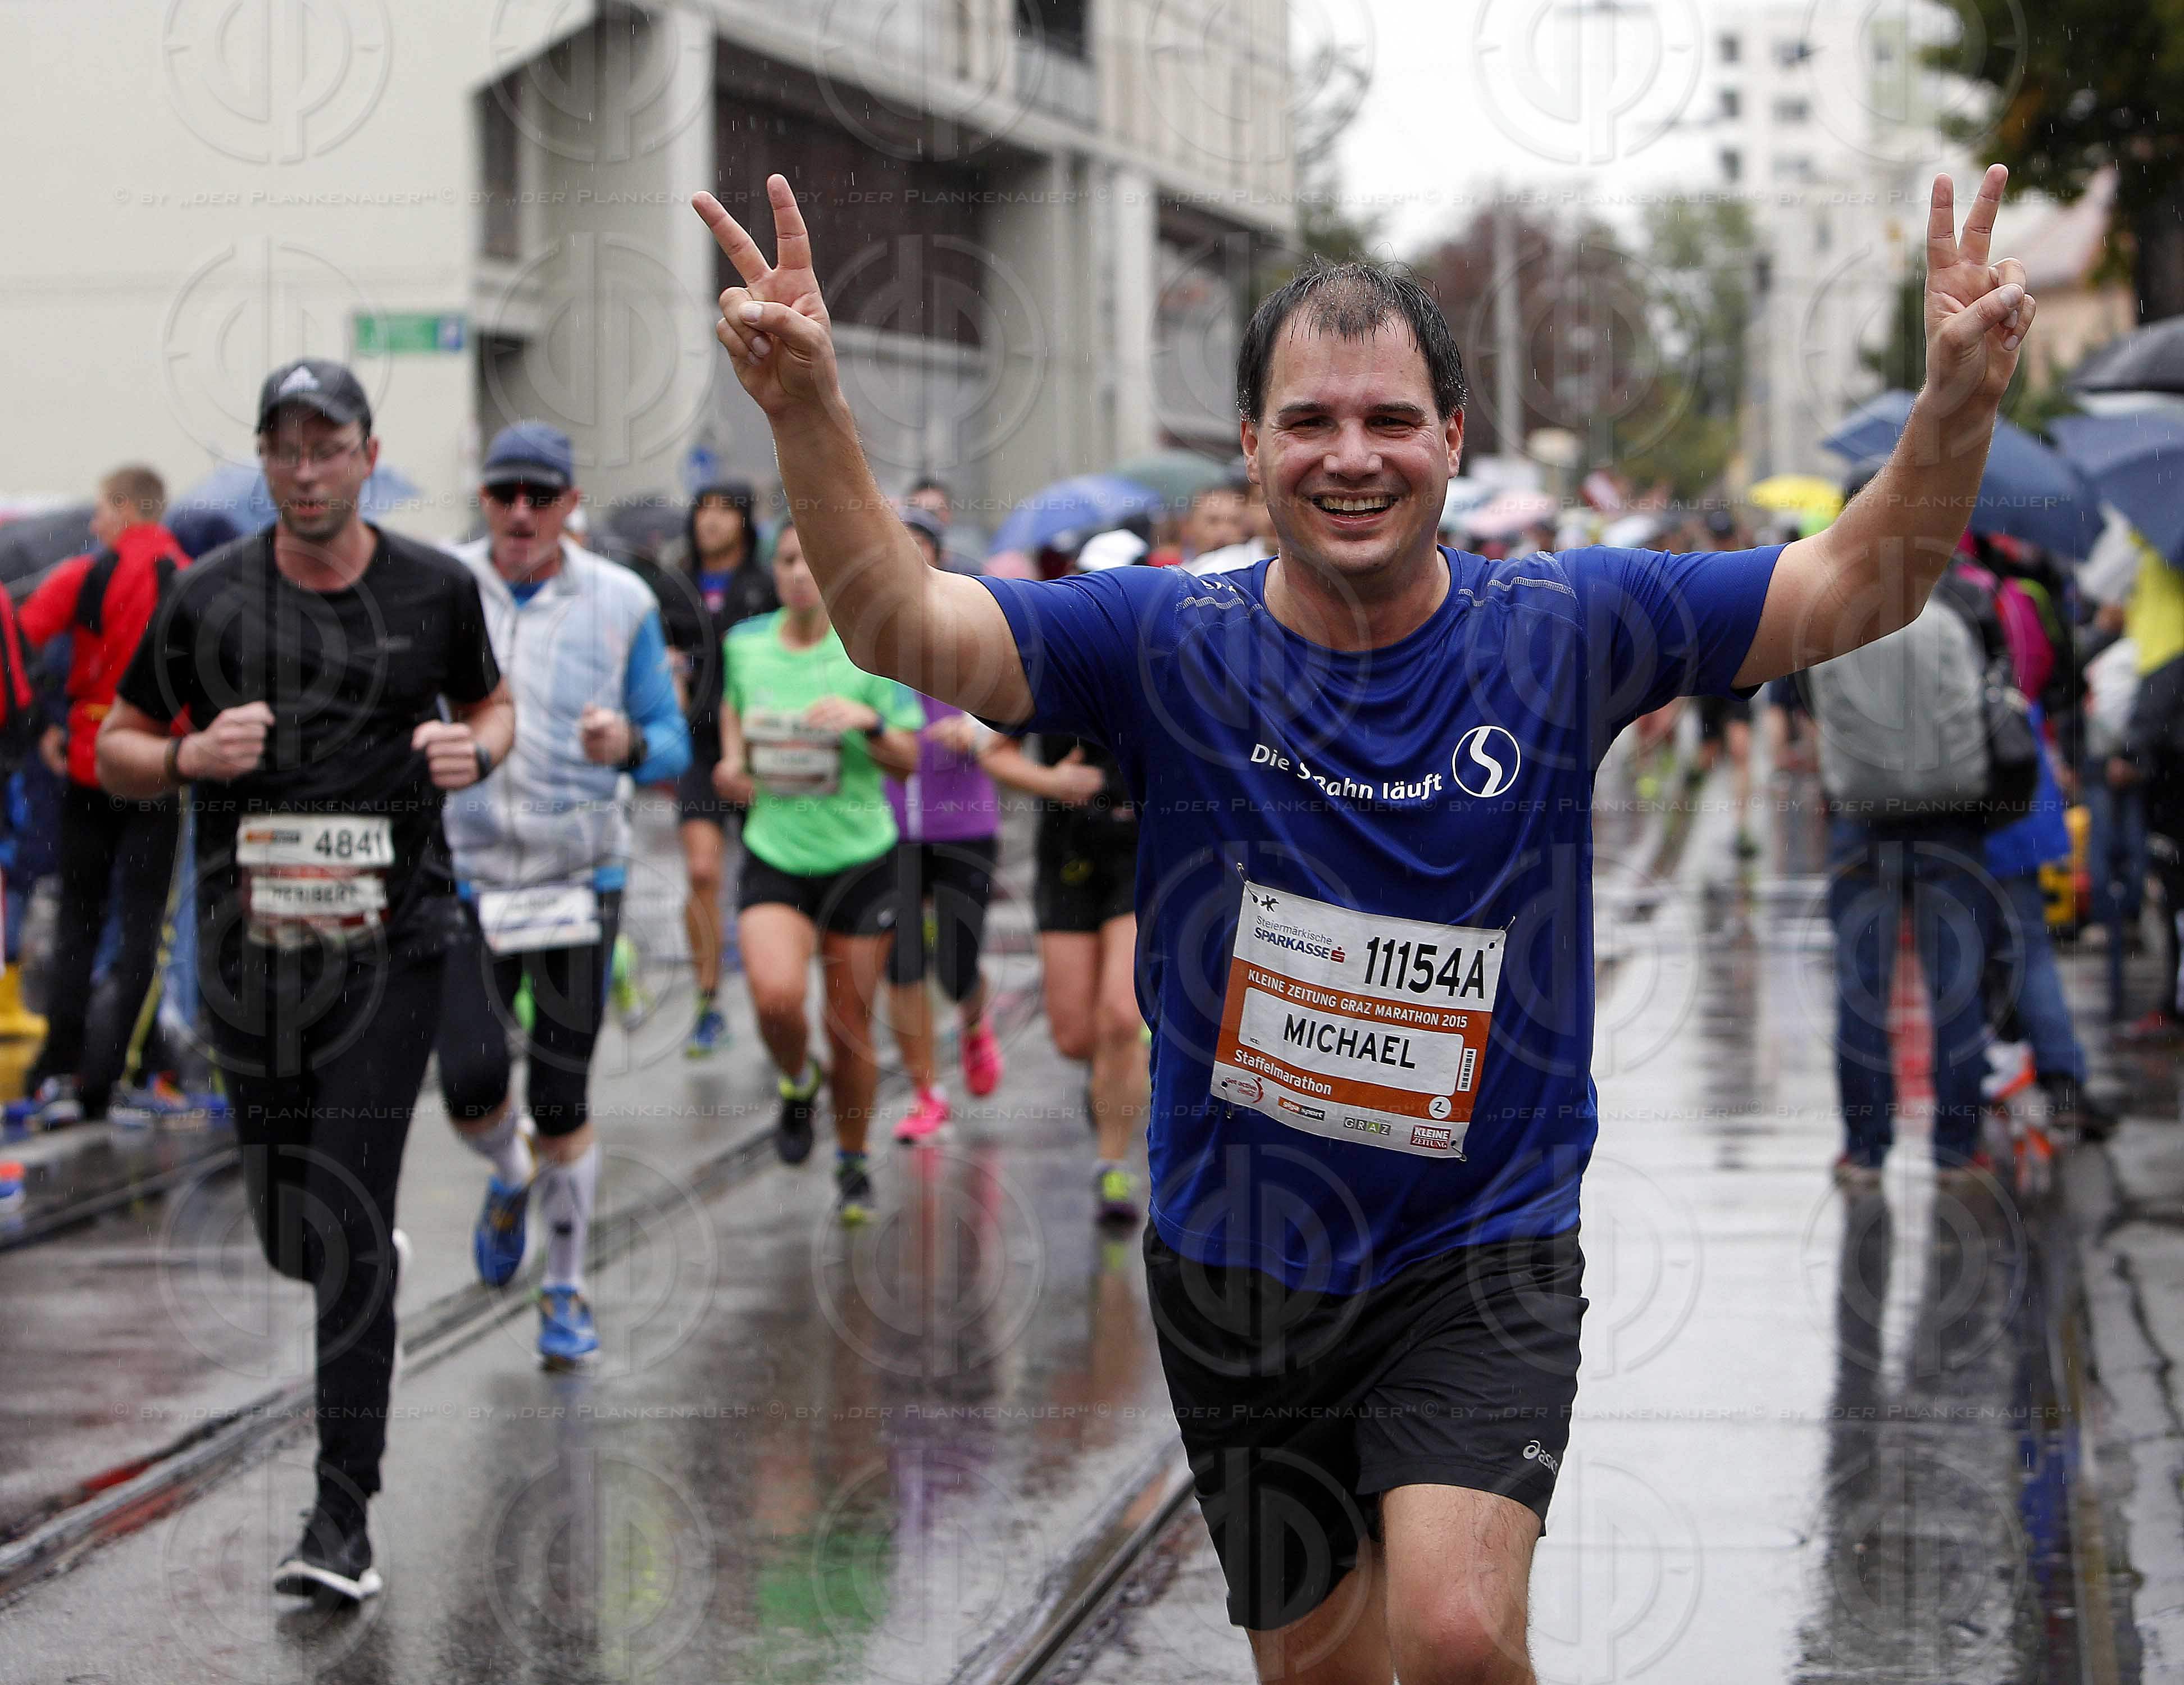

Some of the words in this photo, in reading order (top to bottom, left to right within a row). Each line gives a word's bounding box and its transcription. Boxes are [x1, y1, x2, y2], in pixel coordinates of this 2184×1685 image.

[1250, 744, 1290, 771] Die
[1297, 762, 1374, 799] Sahn
[1382, 772, 1443, 800] läuft
[1254, 927, 1331, 959] SPARKASSE
[1256, 915, 1333, 945] Steiermärkische
[1364, 936, 1485, 1000] 11154A
[1248, 969, 1286, 993] KLEINE
[1287, 983, 1337, 1008] ZEITUNG
[1340, 999, 1372, 1015] GRAZ
[1375, 1004, 1439, 1026] MARATHON
[1441, 1014, 1468, 1028] 2015
[1283, 1013, 1416, 1069] MICHAEL
[1234, 1049, 1332, 1095] Staffelmarathon
[1344, 1117, 1391, 1136] GRAZ
[1412, 1137, 1448, 1149] ZEITUNG
[1413, 1127, 1450, 1140] KLEINE
